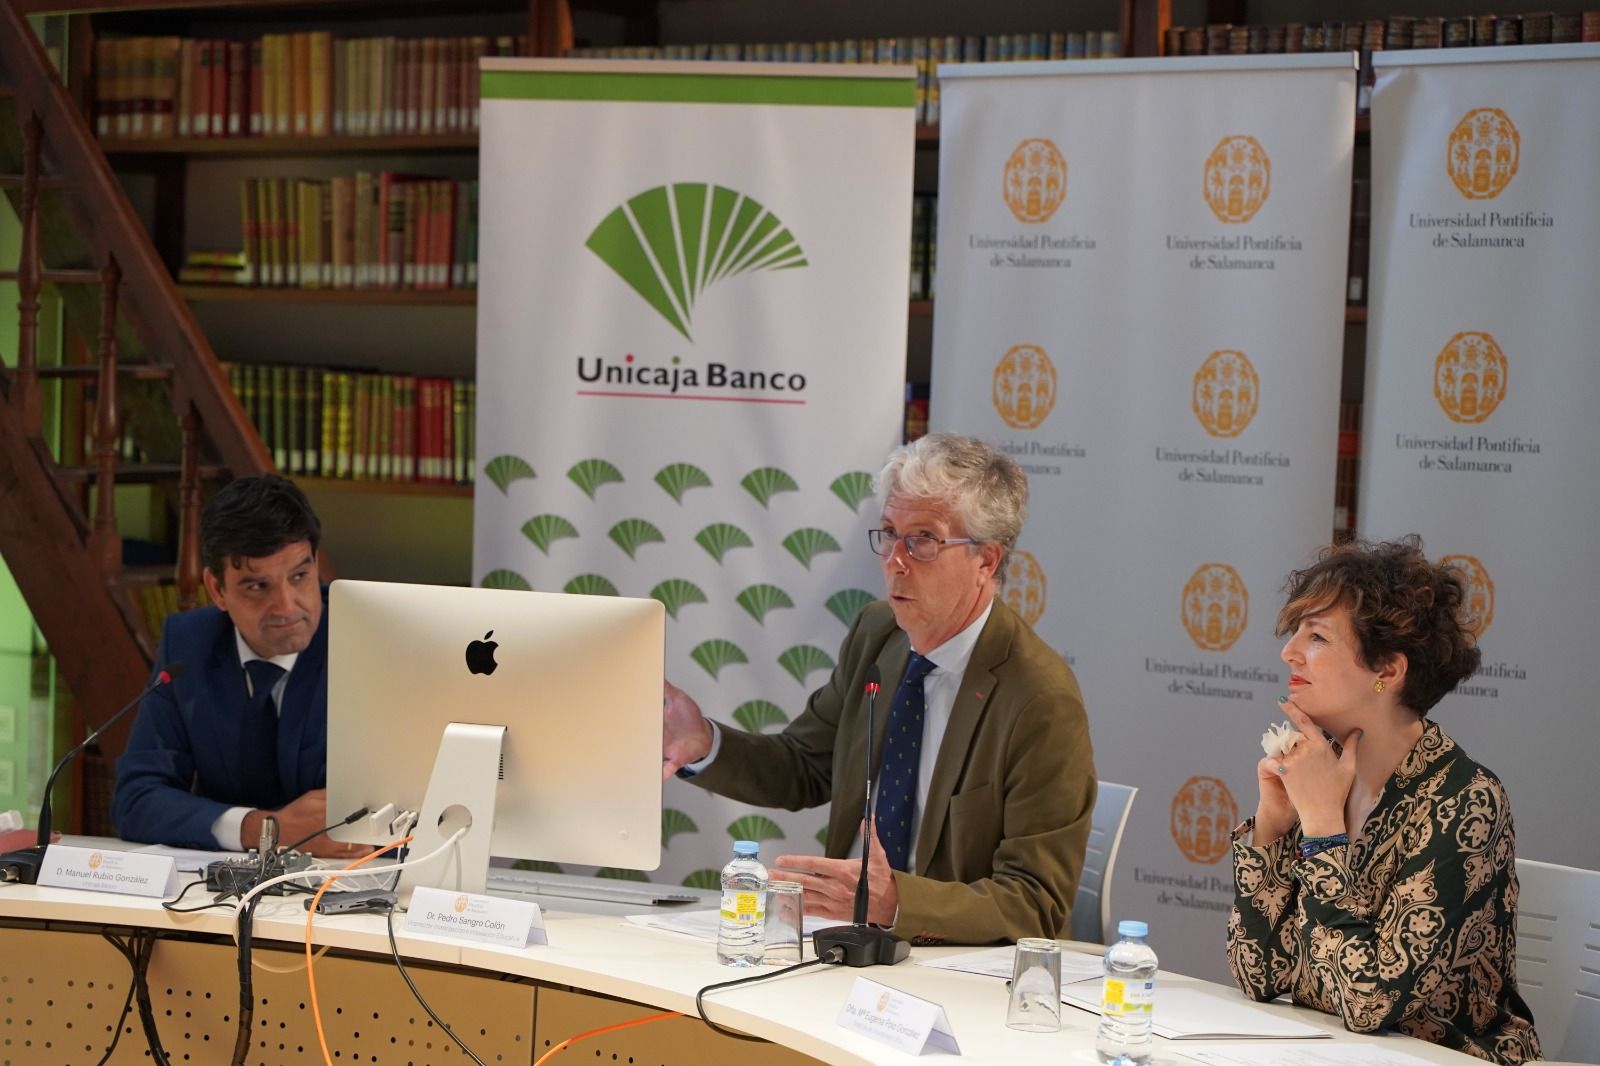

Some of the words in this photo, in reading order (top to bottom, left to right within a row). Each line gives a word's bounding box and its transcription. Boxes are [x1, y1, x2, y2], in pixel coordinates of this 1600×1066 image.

[1409, 212, 1486, 228] Universidad
[1490, 211, 1554, 227] Pontificia
[969, 234, 1039, 249] Universidad
[1041, 234, 1097, 249] Pontificia
[1166, 235, 1240, 250] Universidad
[1243, 235, 1302, 250] Pontificia
[1432, 233, 1449, 248] de
[1451, 233, 1525, 248] Salamanca
[990, 253, 1005, 268] de
[1006, 253, 1072, 268] Salamanca
[1189, 255, 1205, 270] de
[1206, 255, 1275, 270] Salamanca
[577, 354, 699, 394] Unicaja
[706, 363, 807, 392] Banco
[1031, 441, 1087, 458] Pontificia
[1395, 433, 1473, 451] Universidad
[1477, 436, 1541, 454] Pontificia
[1155, 446, 1229, 465] Universidad
[1232, 450, 1290, 467] Pontificia
[1418, 455, 1435, 470] de
[1437, 454, 1512, 473] Salamanca
[1178, 467, 1194, 482] de
[1196, 467, 1264, 486] Salamanca
[1145, 657, 1219, 678] Universidad
[1222, 663, 1279, 683] Pontificia
[1167, 679, 1183, 694] de
[1185, 680, 1254, 700] Salamanca
[66, 868, 91, 879] Manuel
[92, 871, 114, 881] Rubio
[115, 873, 149, 885] González
[1134, 867, 1208, 891] Universidad
[1157, 890, 1172, 904] de
[426, 911, 436, 921] Dr.
[437, 912, 458, 924] Pedro
[459, 916, 484, 928] Sangro
[484, 919, 506, 931] Colón
